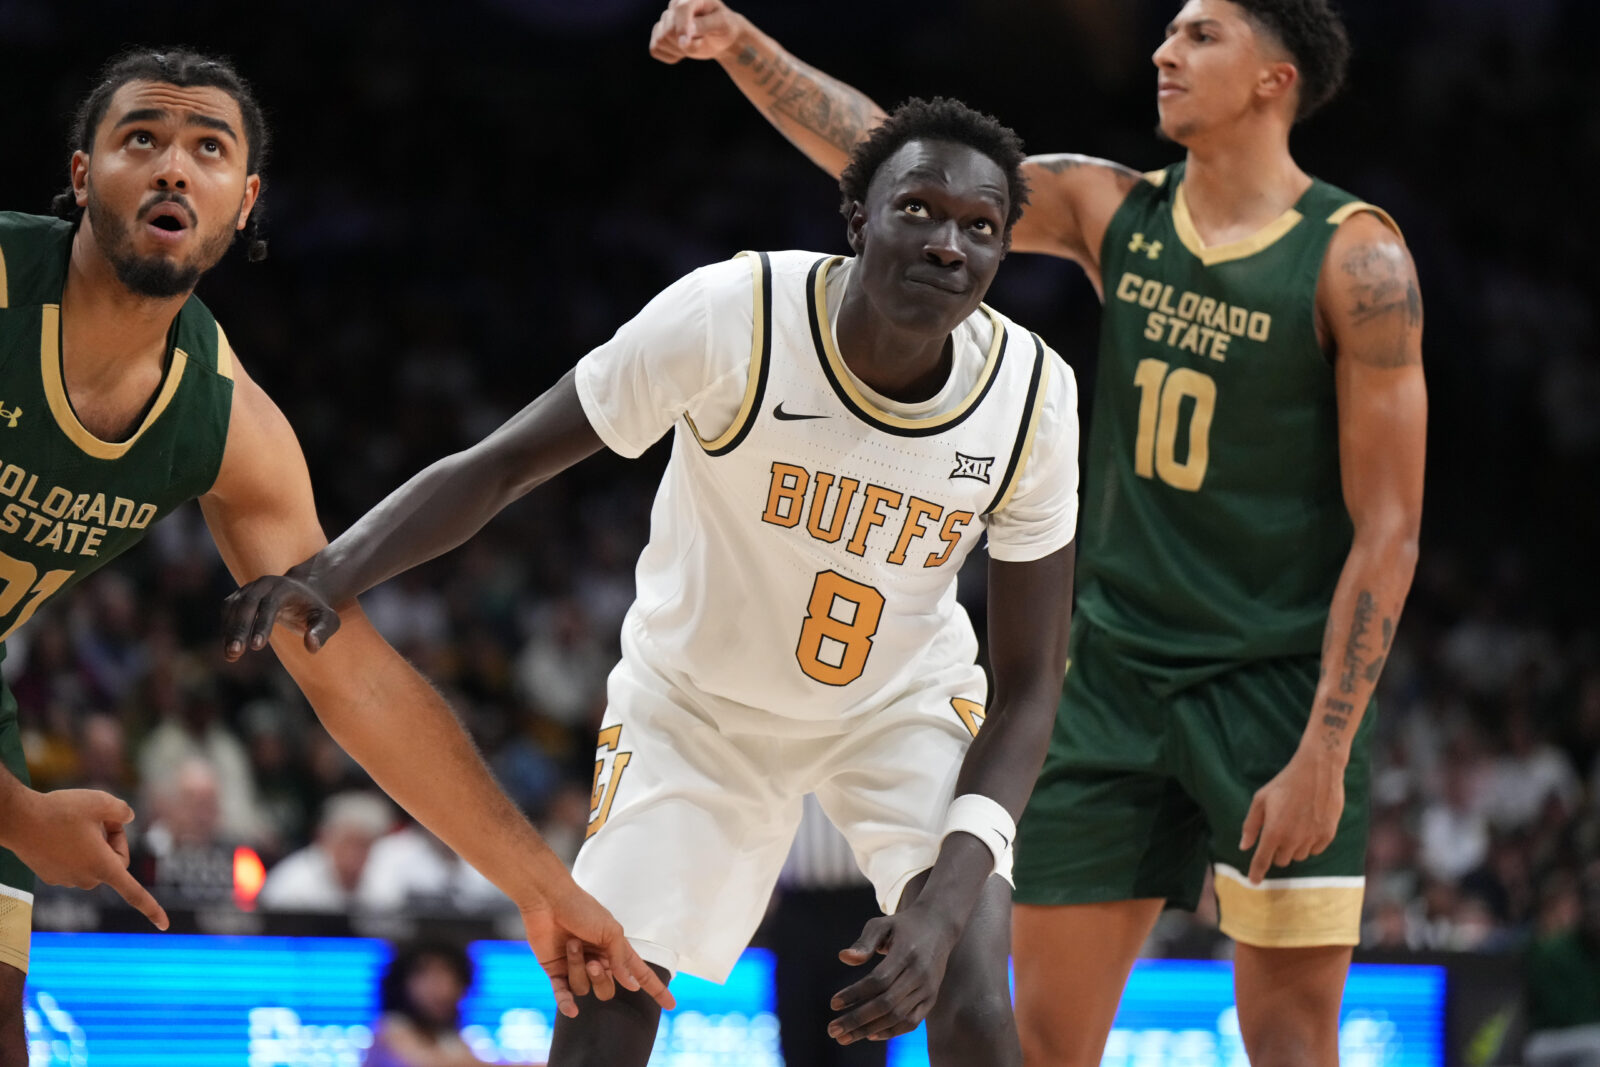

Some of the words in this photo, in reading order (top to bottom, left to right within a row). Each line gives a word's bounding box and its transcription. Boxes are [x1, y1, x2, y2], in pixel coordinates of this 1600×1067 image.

[1116, 272, 1271, 342] COLORADO
[1144, 311, 1231, 362] STATE
[1133, 358, 1217, 492] 10
[0, 459, 157, 529] OLORADO
[762, 461, 974, 568] BUFFS
[0, 503, 107, 557] STATE
[796, 569, 886, 686] 8
